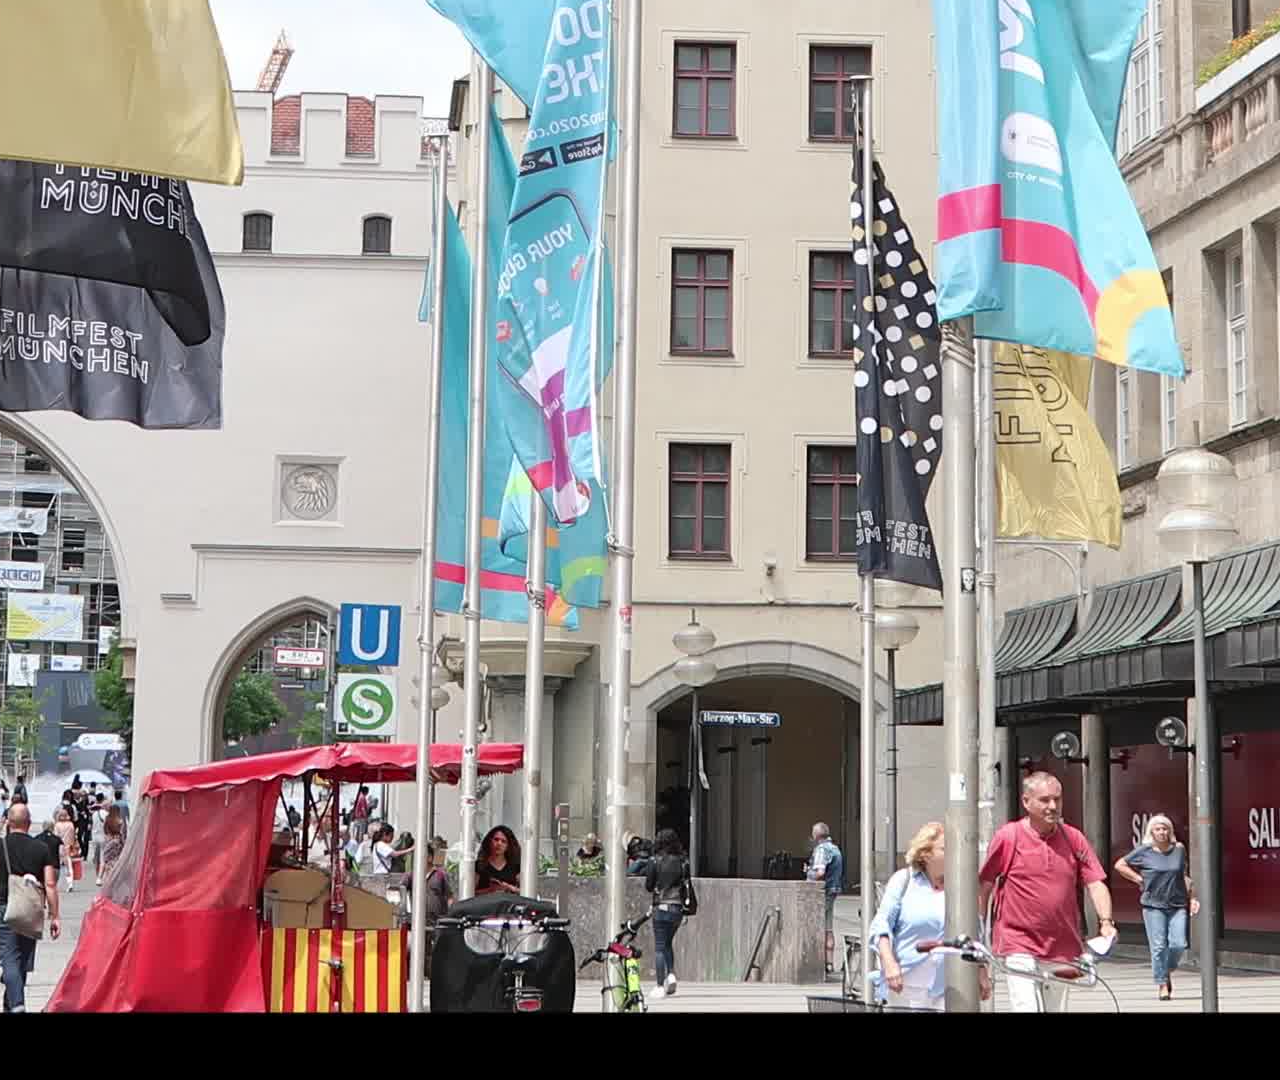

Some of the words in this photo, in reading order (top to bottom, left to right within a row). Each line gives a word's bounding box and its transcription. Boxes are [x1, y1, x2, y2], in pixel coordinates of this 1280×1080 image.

[0, 308, 143, 356] FILMFEST
[886, 536, 932, 560] HEN
[351, 608, 390, 661] U
[350, 684, 384, 726] S
